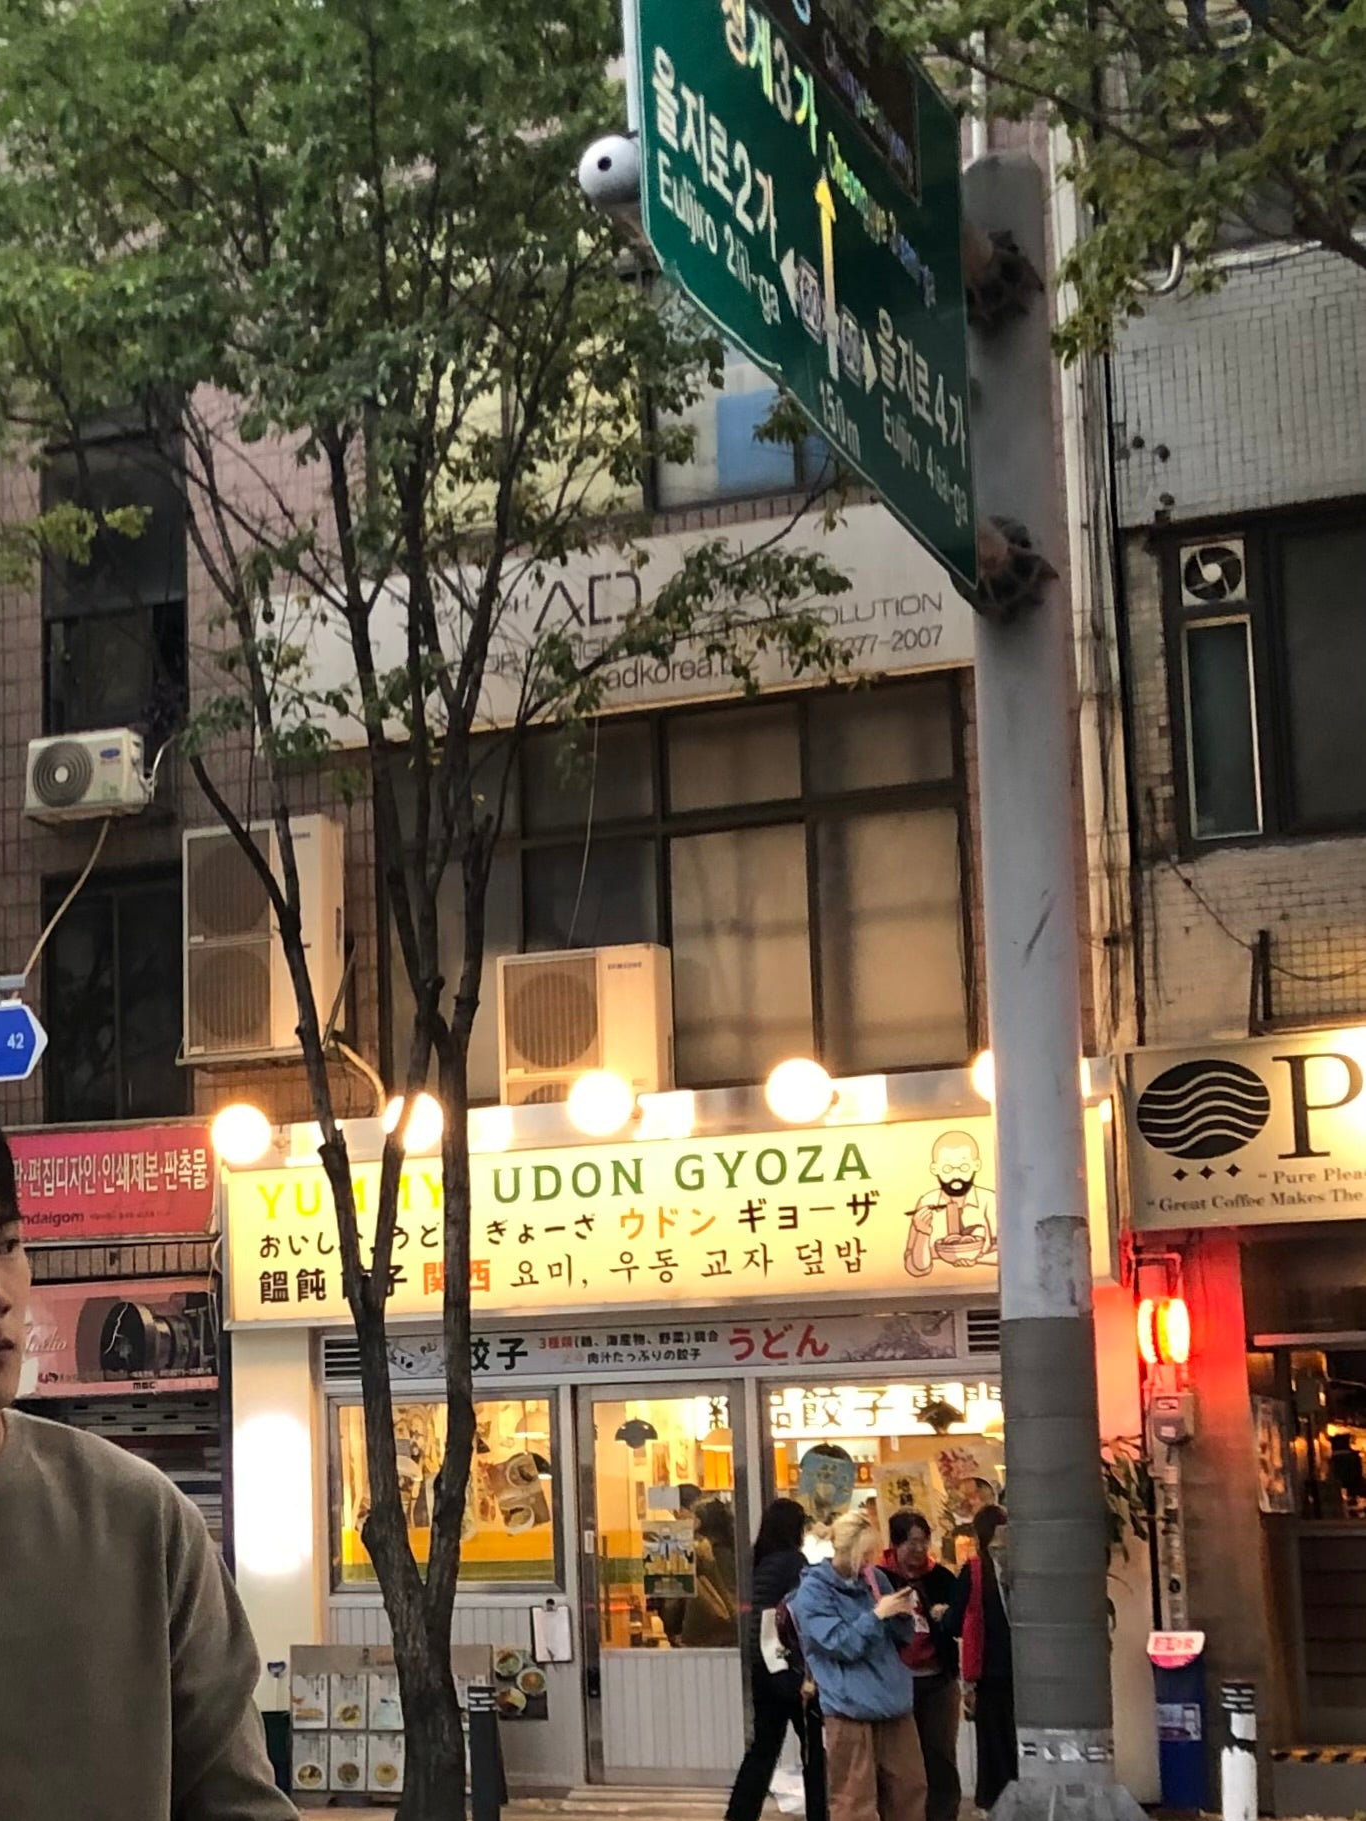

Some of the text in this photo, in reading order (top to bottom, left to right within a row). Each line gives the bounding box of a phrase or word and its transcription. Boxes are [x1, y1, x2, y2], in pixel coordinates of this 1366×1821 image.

[652, 45, 778, 263] 을지로2가
[657, 149, 718, 256] Euljiro
[876, 307, 966, 469] 을지로4가
[7, 1033, 25, 1050] 42
[492, 1158, 645, 1204] UDON
[674, 1142, 872, 1192] GYOZA
[1274, 1162, 1366, 1185] Pure Plea
[1331, 1185, 1365, 1204] The
[486, 1213, 595, 1245] ぎょーざ
[620, 1206, 716, 1240] ウドン
[738, 1190, 879, 1233] ギョーザ
[609, 1249, 679, 1284] 우동
[700, 1241, 774, 1279] 교자
[795, 1235, 867, 1276] 덮밥
[729, 1324, 830, 1362] うどん
